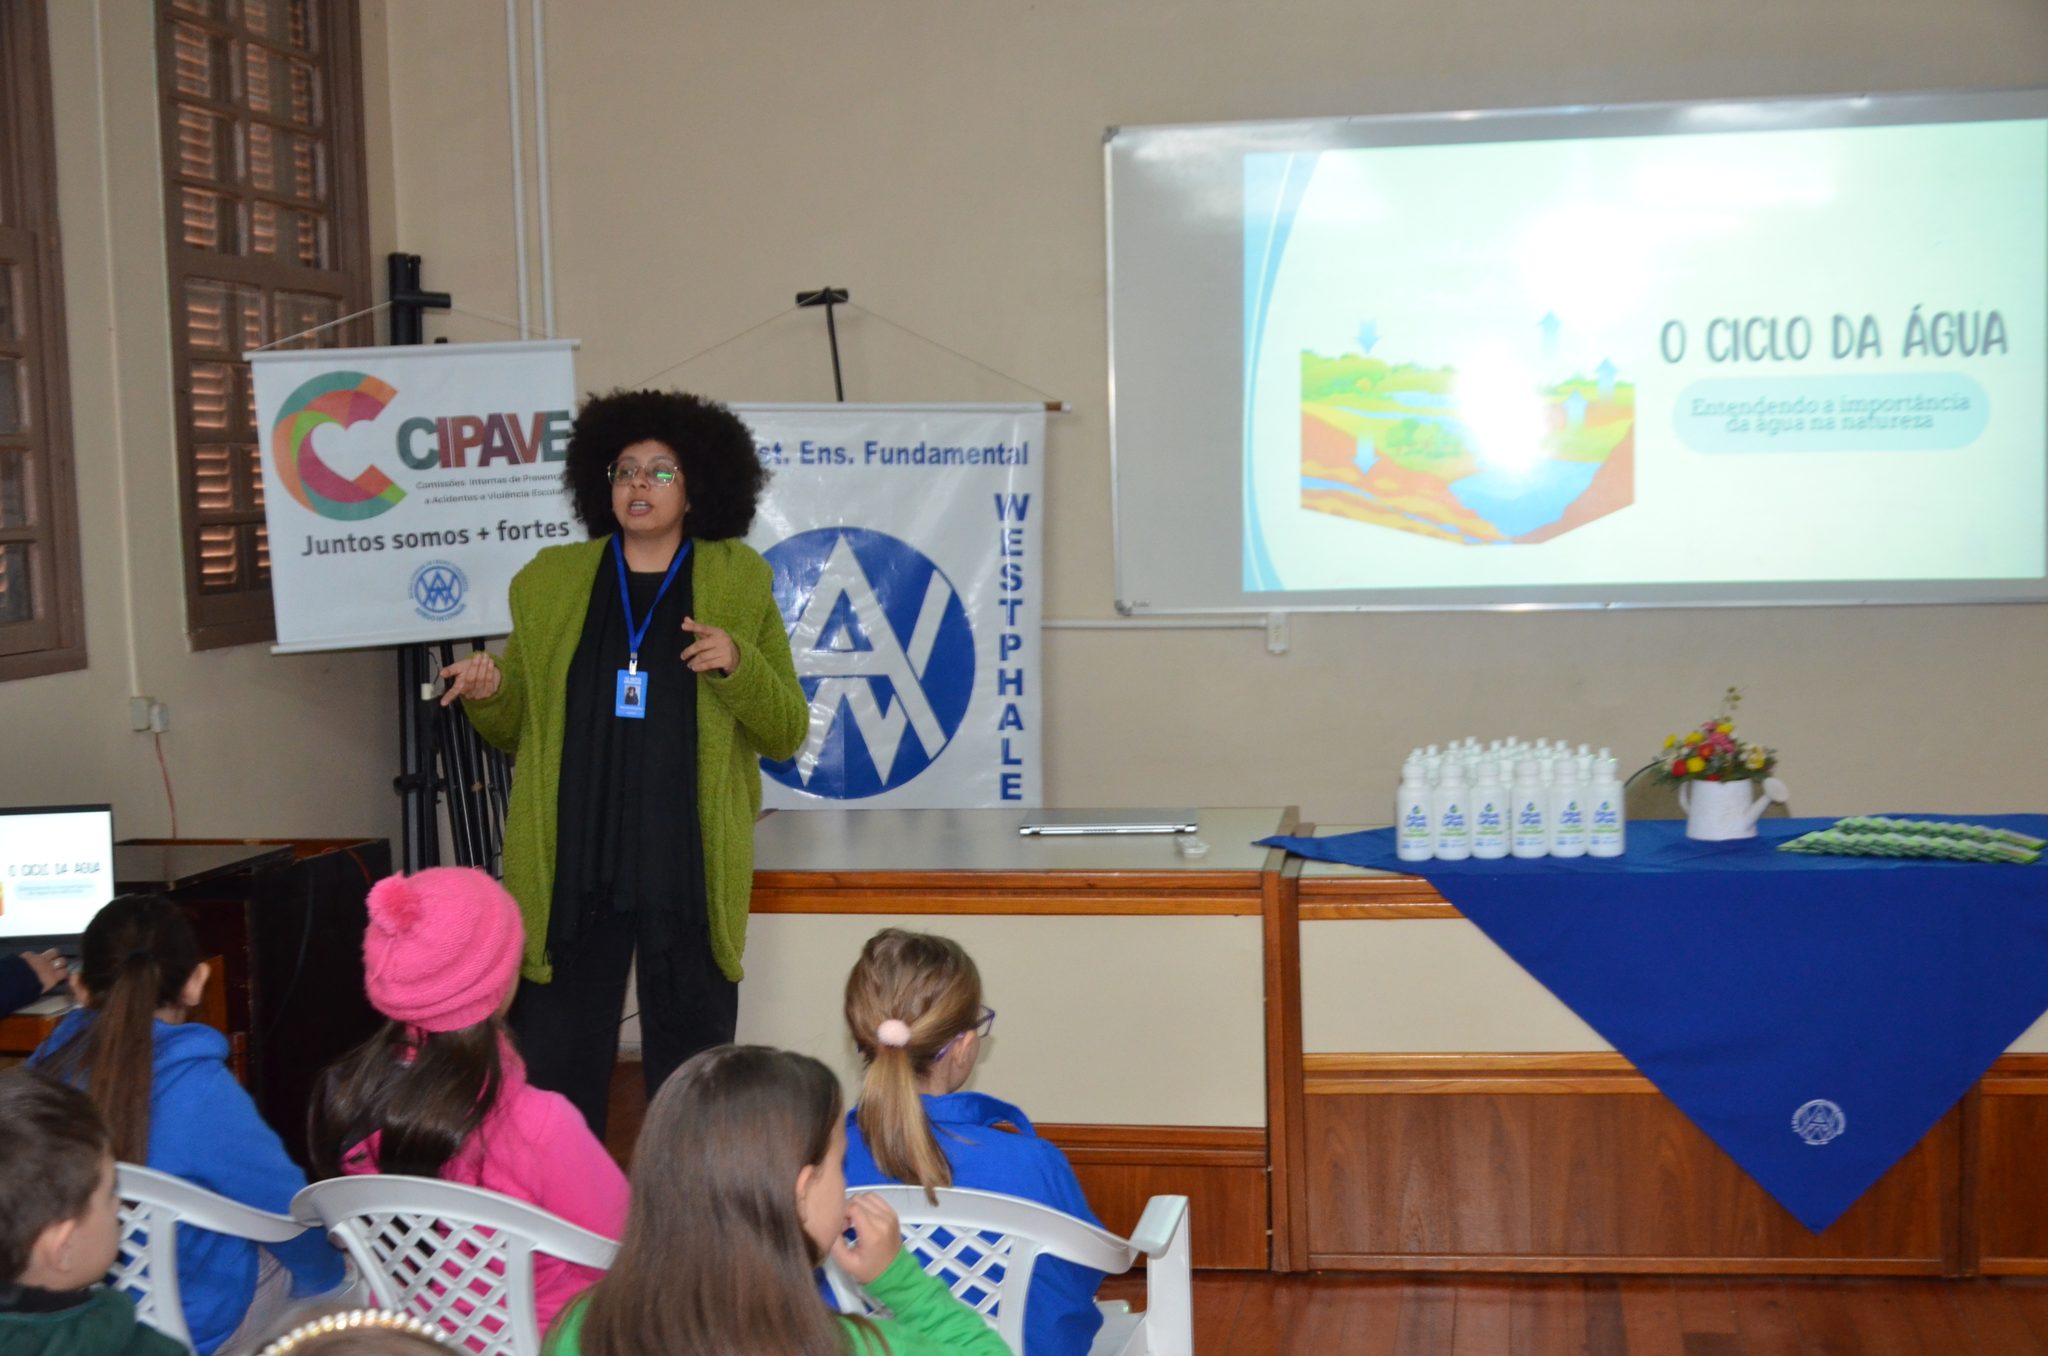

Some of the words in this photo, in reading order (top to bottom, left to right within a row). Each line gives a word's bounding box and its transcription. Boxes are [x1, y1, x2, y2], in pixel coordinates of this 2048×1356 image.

[1660, 319, 1686, 364] O
[1706, 315, 1812, 363] CICLO
[1831, 313, 1883, 360] DA
[1902, 303, 2009, 359] ÁGUA
[1691, 395, 1818, 417] Entendendo
[1840, 393, 1971, 419] importância
[1841, 414, 1934, 431] natureza
[396, 409, 569, 471] CIPAVE
[800, 440, 854, 465] Ens.
[864, 440, 1029, 465] Fundamental
[301, 531, 385, 556] Juntos
[392, 527, 470, 549] somos
[496, 519, 570, 541] fortes
[993, 493, 1031, 801] WESTPHALE
